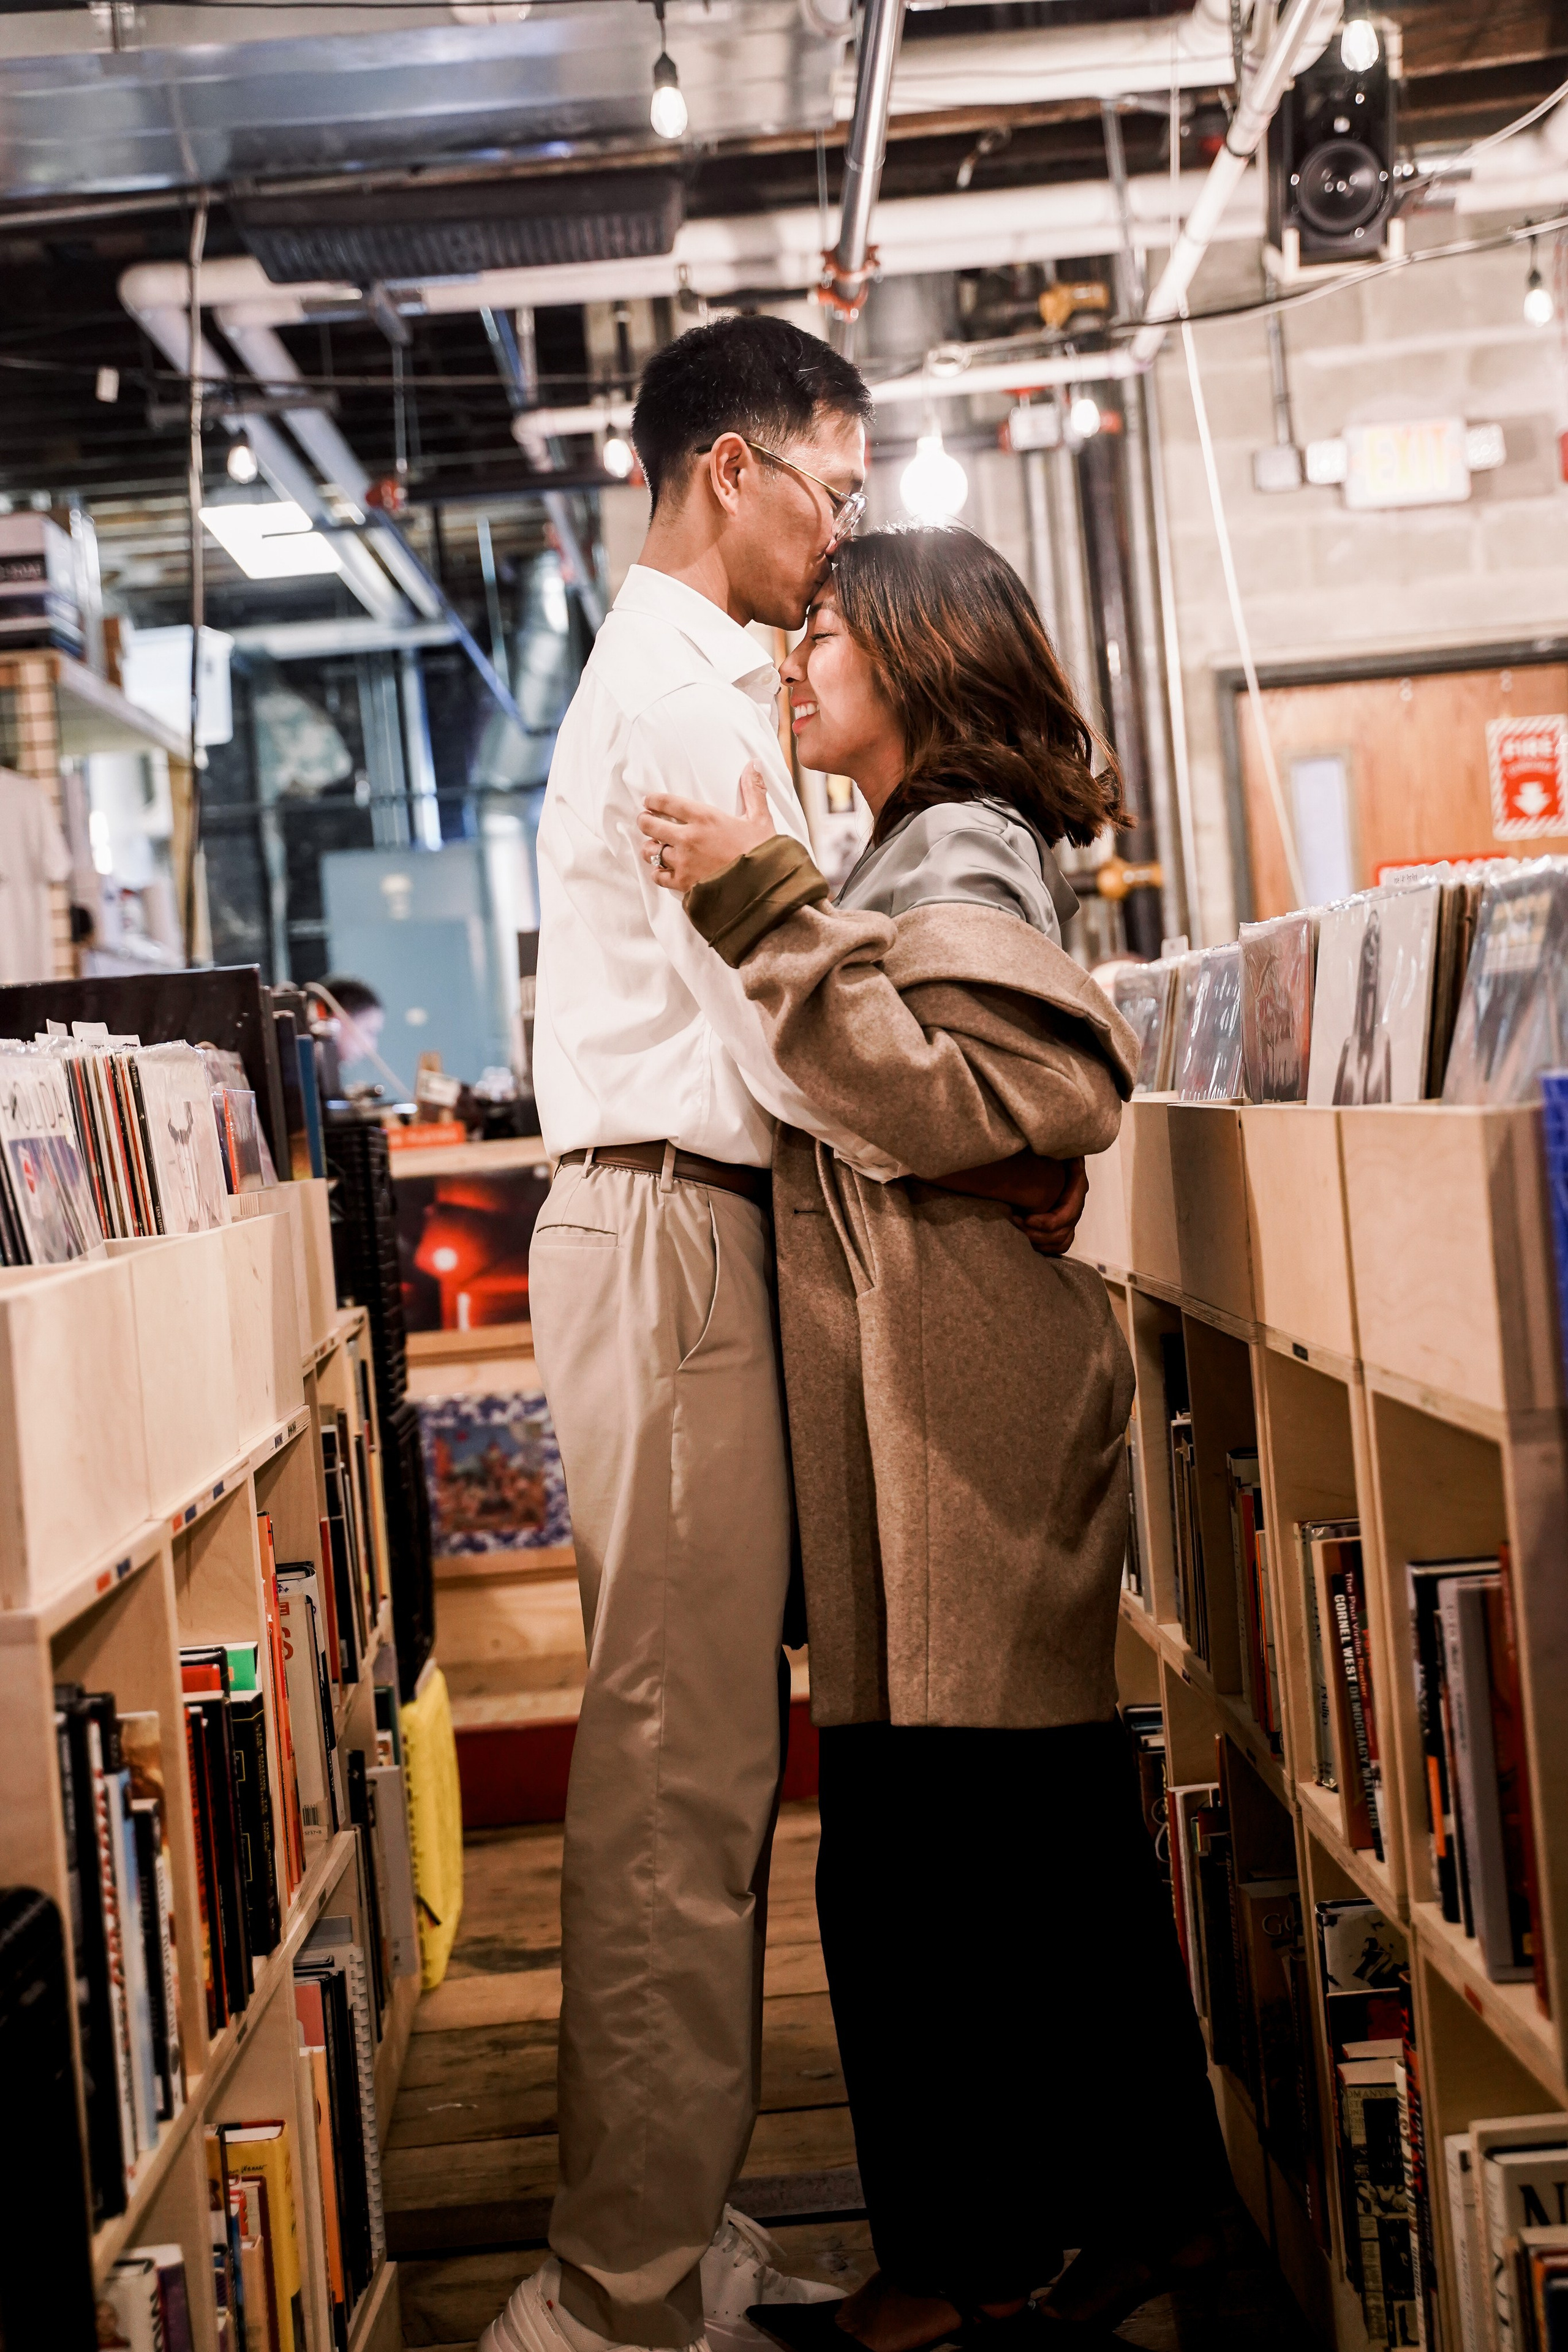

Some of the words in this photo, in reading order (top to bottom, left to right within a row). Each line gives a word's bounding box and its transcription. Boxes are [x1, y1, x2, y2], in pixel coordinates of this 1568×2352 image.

[1364, 421, 1453, 494] EXIT
[1344, 1571, 1355, 1593] The
[1333, 1594, 1351, 1645] CORNEL
[1348, 1596, 1359, 1621] Paul
[1352, 1622, 1363, 1654] Virilio
[1341, 1646, 1358, 1683] WEST
[1356, 1657, 1368, 1698] Reader
[1348, 1685, 1368, 1764] DEMOCRACY
[1361, 1767, 1379, 1830] MATTERS
